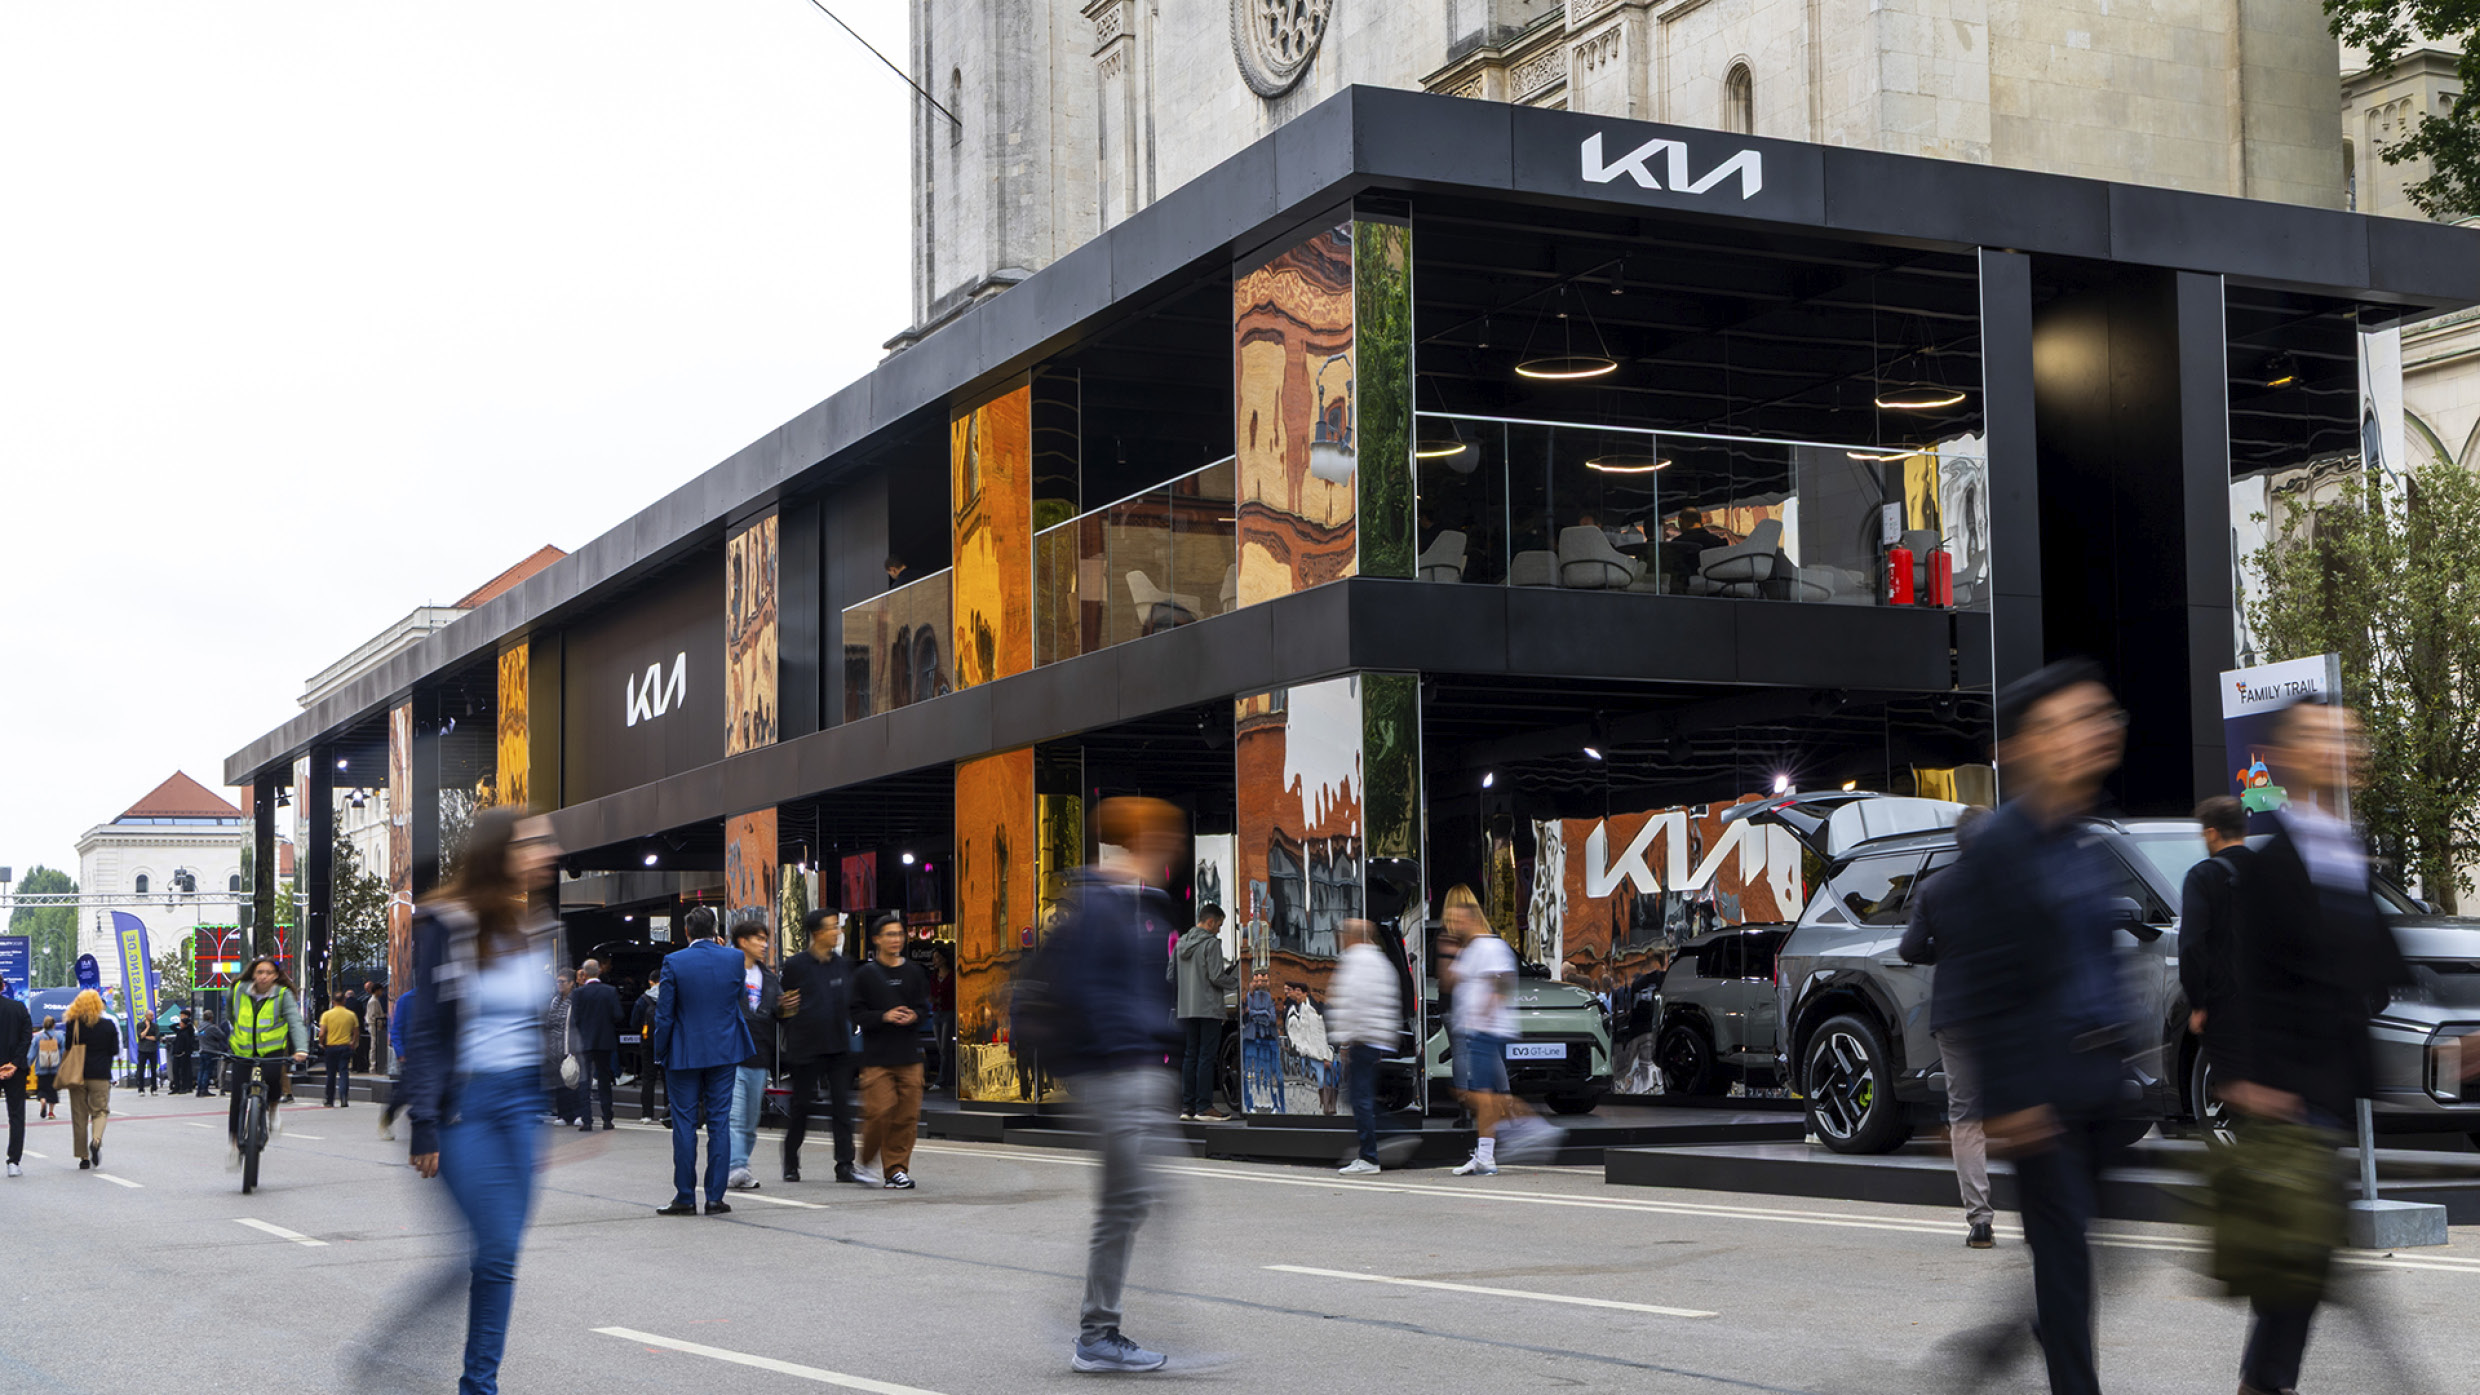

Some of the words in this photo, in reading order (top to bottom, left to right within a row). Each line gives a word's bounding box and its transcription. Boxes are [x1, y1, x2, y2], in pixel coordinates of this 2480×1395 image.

[1581, 131, 1763, 201] KIA
[626, 651, 687, 727] KIA
[2240, 684, 2281, 704] FAMILY
[2284, 678, 2318, 697] TRAIL
[1586, 811, 1767, 899] KIA
[1512, 1047, 1529, 1056] EV3
[1530, 1047, 1560, 1056] GT-Line
